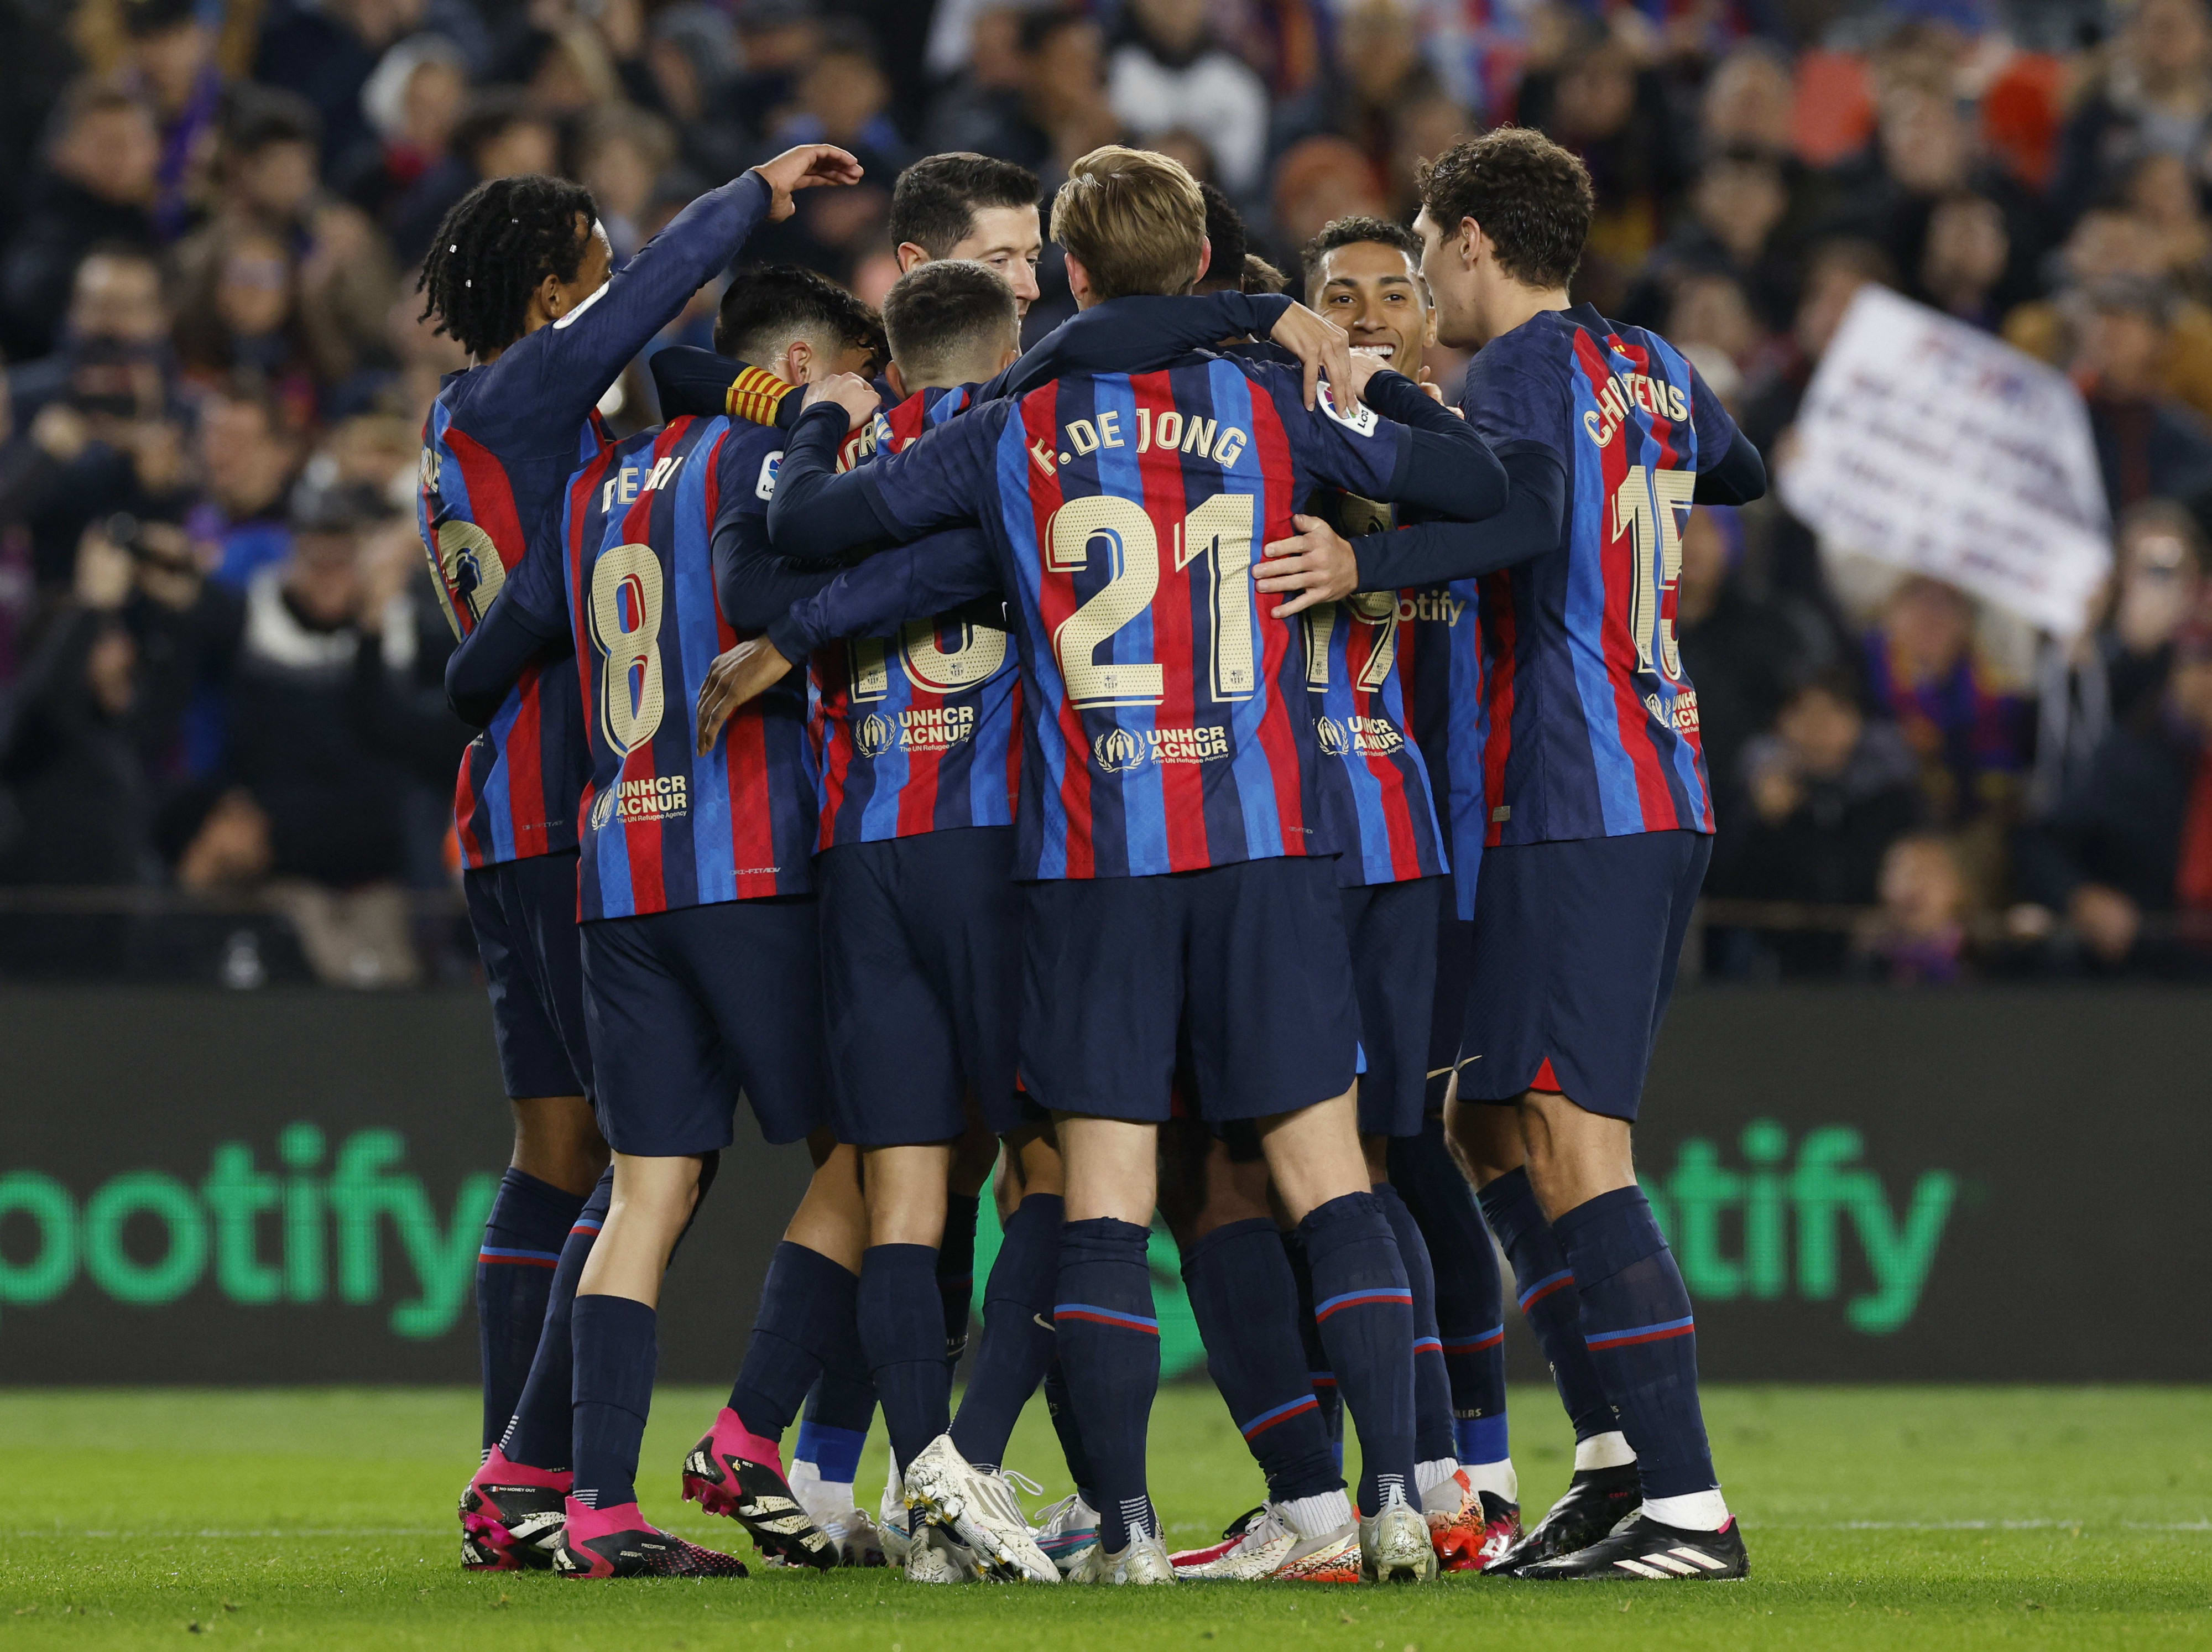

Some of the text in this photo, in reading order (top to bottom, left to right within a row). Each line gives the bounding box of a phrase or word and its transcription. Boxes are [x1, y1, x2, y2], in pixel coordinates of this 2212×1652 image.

[1136, 408, 1248, 468] JONG
[1611, 465, 1697, 680] 15
[1045, 493, 1255, 710] 21
[588, 543, 664, 759] 8
[898, 706, 974, 728] UNHCR
[898, 723, 973, 746] ACNUR
[1146, 725, 1226, 746] UNHCR
[923, 743, 950, 752] Refugee
[1150, 738, 1229, 761] ACNUR
[1205, 753, 1229, 763] Agency
[616, 775, 686, 799] UNHCR
[615, 793, 687, 816] ACNUR
[638, 814, 665, 822] Refugee
[665, 810, 687, 820] Agency
[641, 1542, 666, 1551] PREDATOR
